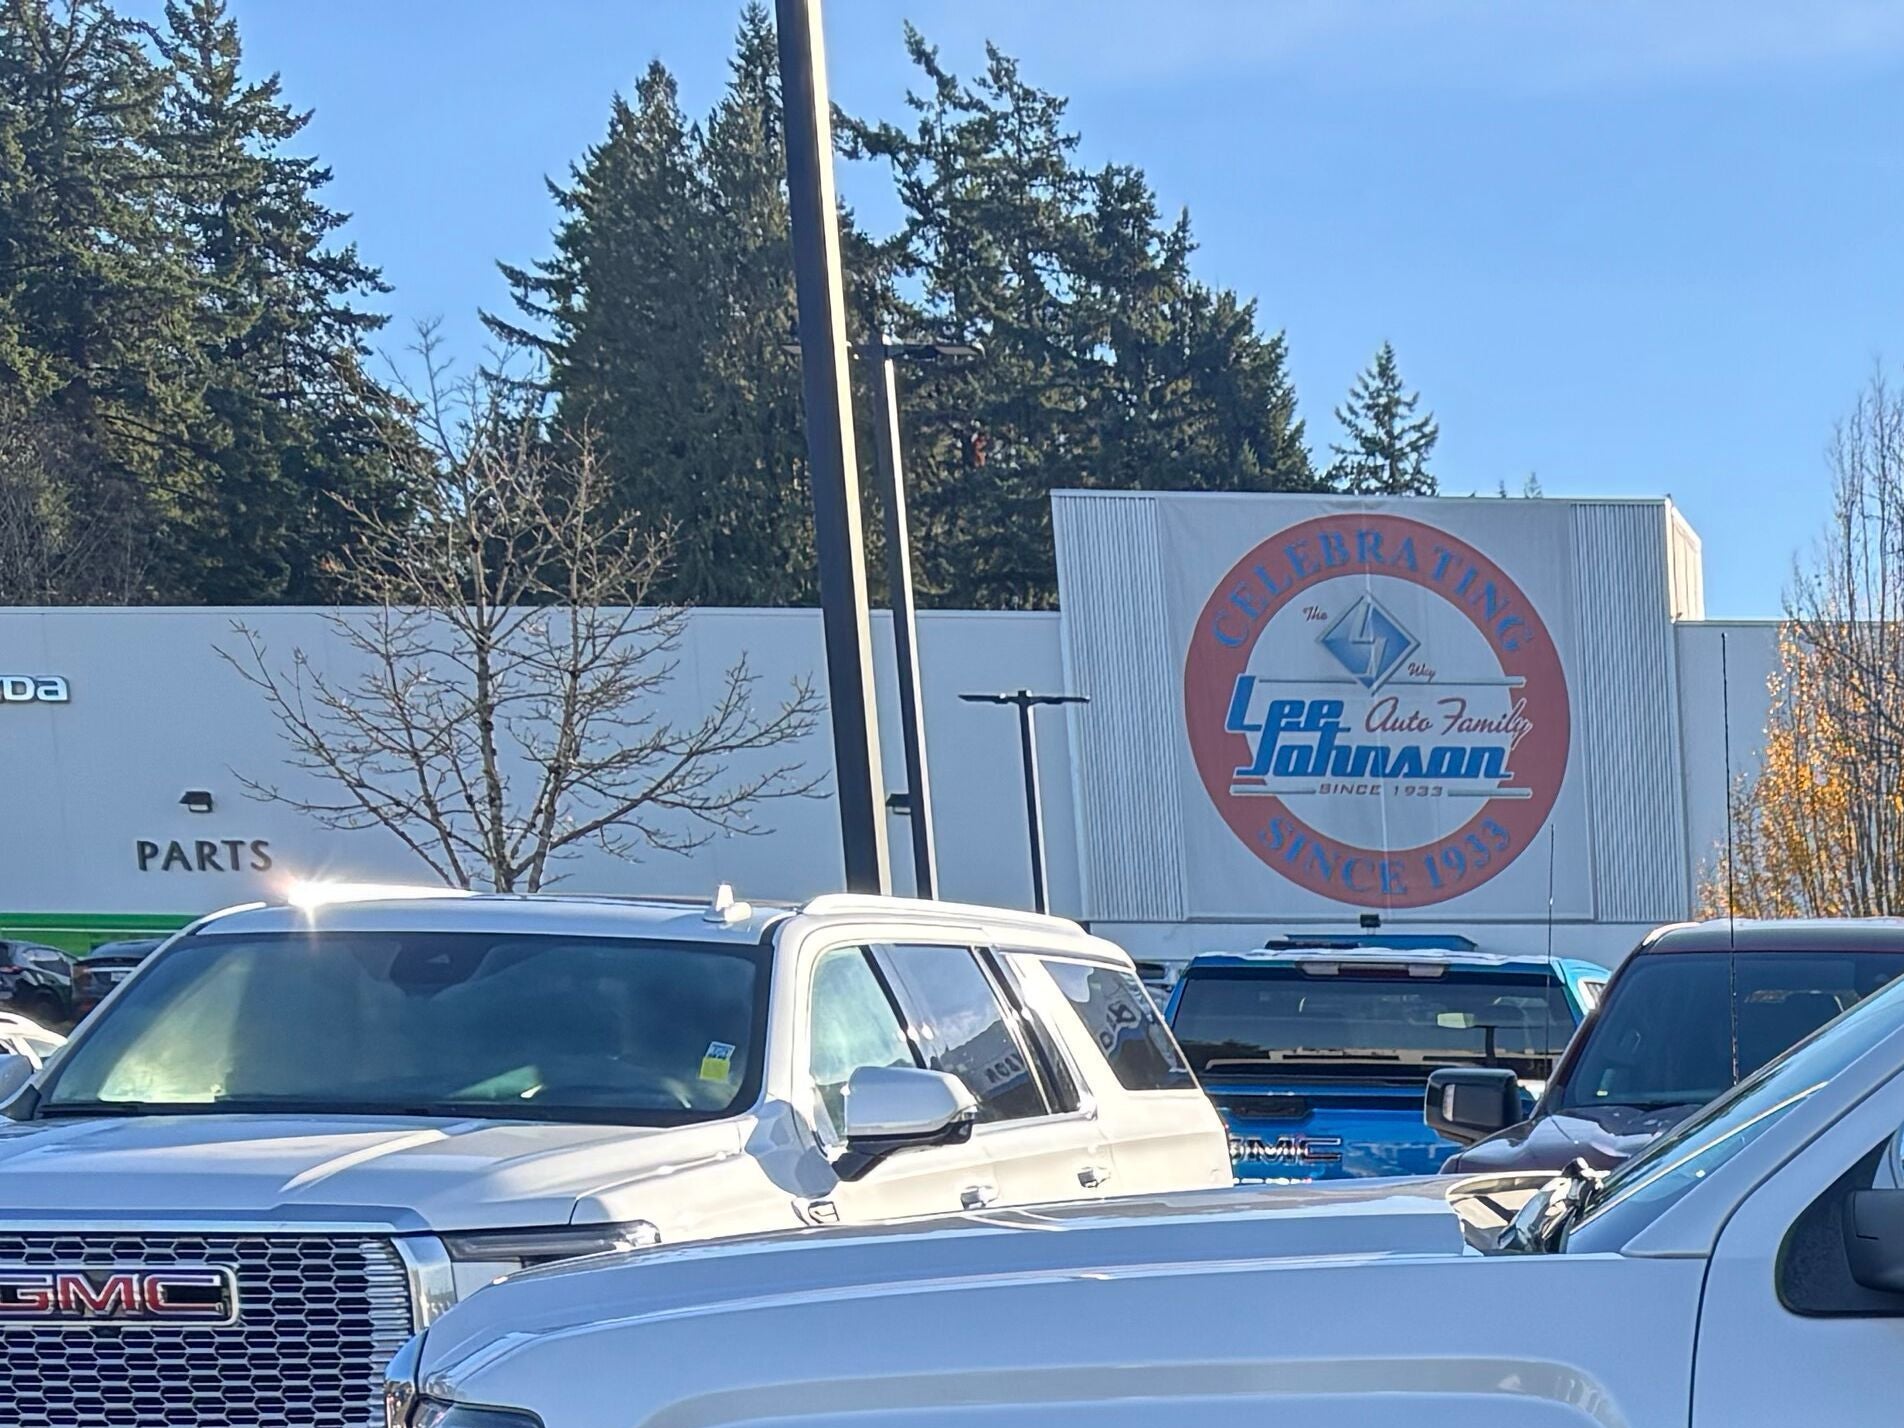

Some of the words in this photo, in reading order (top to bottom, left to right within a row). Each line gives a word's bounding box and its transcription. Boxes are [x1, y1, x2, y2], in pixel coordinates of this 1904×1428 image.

[1211, 528, 1534, 653] CELEBRATING
[1303, 606, 1328, 622] The
[1408, 662, 1436, 683] Way
[1226, 675, 1352, 732] Lee
[1365, 696, 1433, 733] Auto
[1437, 697, 1532, 750] Family
[1236, 715, 1513, 778] Johnson
[1318, 783, 1382, 796] SINCE
[1393, 784, 1444, 797] 1933
[136, 840, 273, 872] PARTS
[1258, 816, 1408, 897] SINCE
[1423, 817, 1512, 890] 1933
[0, 1273, 221, 1316] GMC
